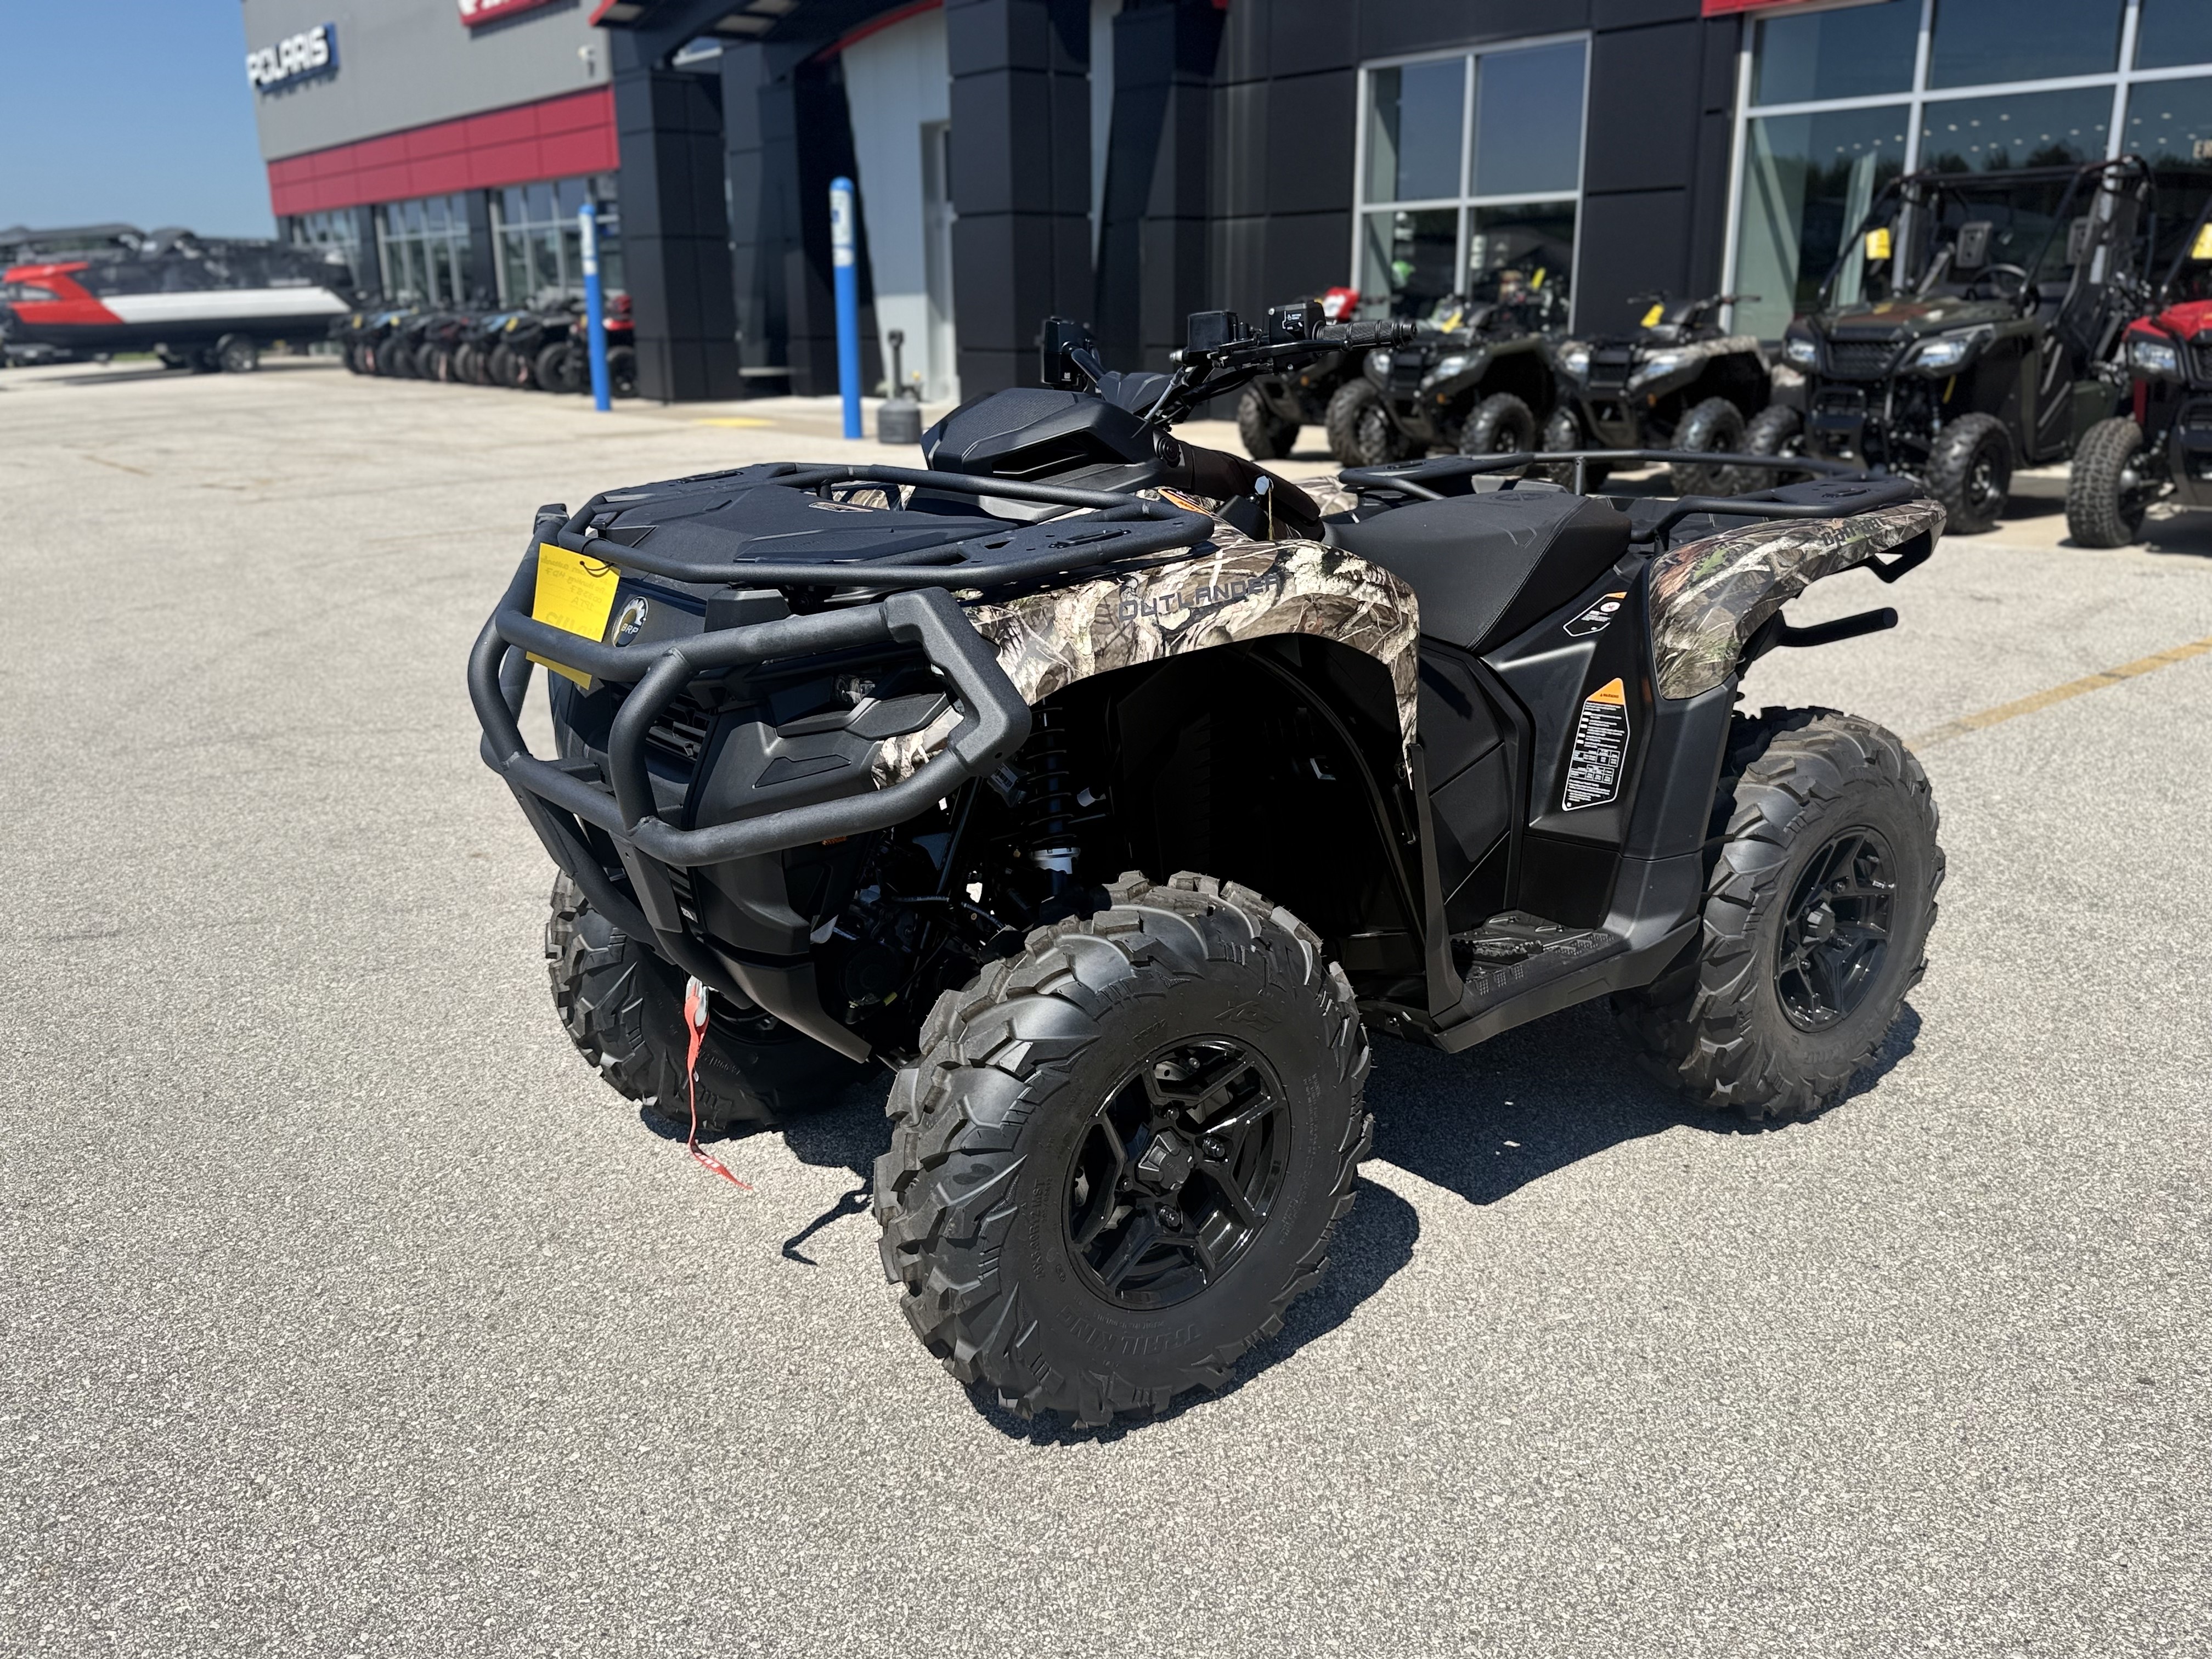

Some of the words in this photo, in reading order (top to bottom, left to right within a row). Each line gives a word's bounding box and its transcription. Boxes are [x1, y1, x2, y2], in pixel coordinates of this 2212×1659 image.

[245, 26, 329, 88] POLARIS
[1119, 574, 1282, 621] OUTLANDER
[620, 623, 639, 635] BRP
[1056, 1303, 1116, 1352] KING
[1121, 1323, 1202, 1356] TRAIL
